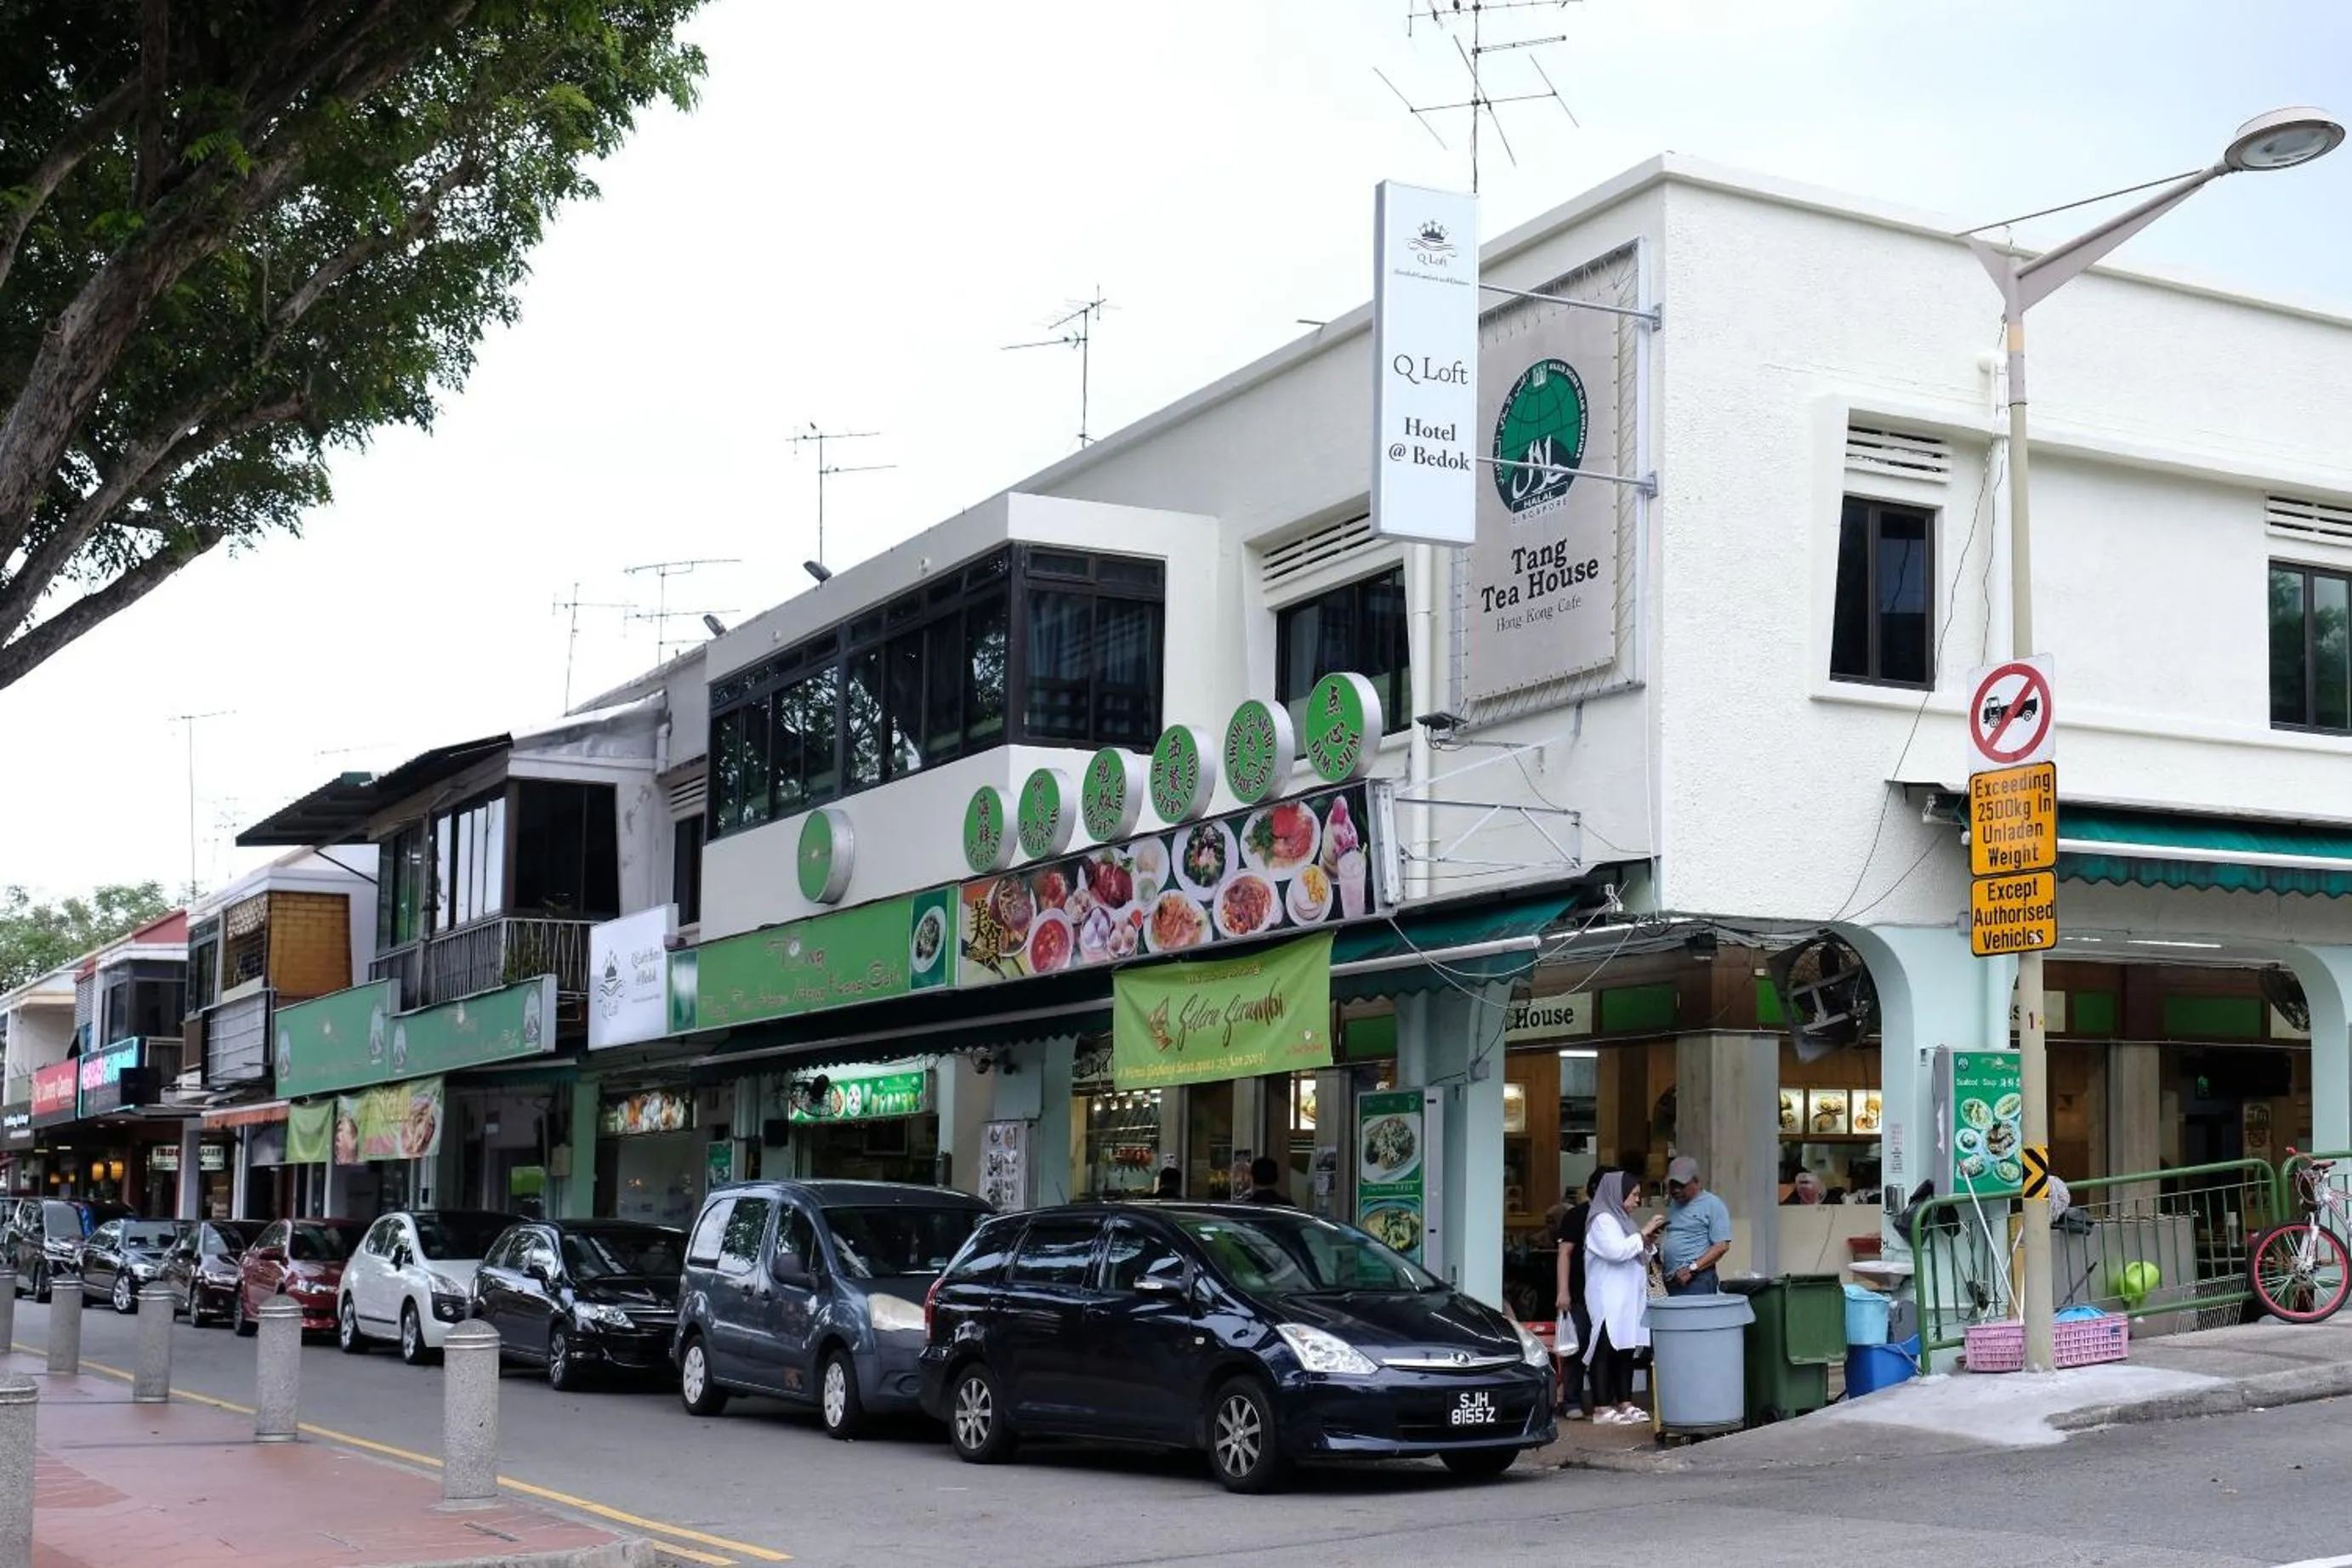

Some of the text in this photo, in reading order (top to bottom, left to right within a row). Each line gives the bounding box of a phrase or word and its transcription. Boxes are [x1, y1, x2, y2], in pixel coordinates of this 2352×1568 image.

[1394, 354, 1469, 385] Q Loft
[1405, 417, 1456, 441] Hotel
[1389, 443, 1470, 471] @ Bedok
[1523, 491, 1555, 508] HALAL
[1511, 537, 1567, 574] Tang
[1480, 558, 1599, 613] Tea House
[1496, 616, 1522, 633] Hong
[1526, 605, 1553, 623] Kong
[1311, 730, 1360, 774] DIM SUM
[1974, 771, 2050, 798] Exceeding
[1978, 793, 2052, 822] 2500kg In
[1983, 820, 2043, 844] Unladen
[1988, 843, 2039, 869] Weight
[1987, 878, 2037, 903] Except
[1974, 900, 2054, 928] Authorised
[1983, 926, 2044, 950] Vehicles
[1514, 1007, 1574, 1029] House
[2028, 1011, 2035, 1030] 1
[1459, 1391, 1489, 1409] SJH
